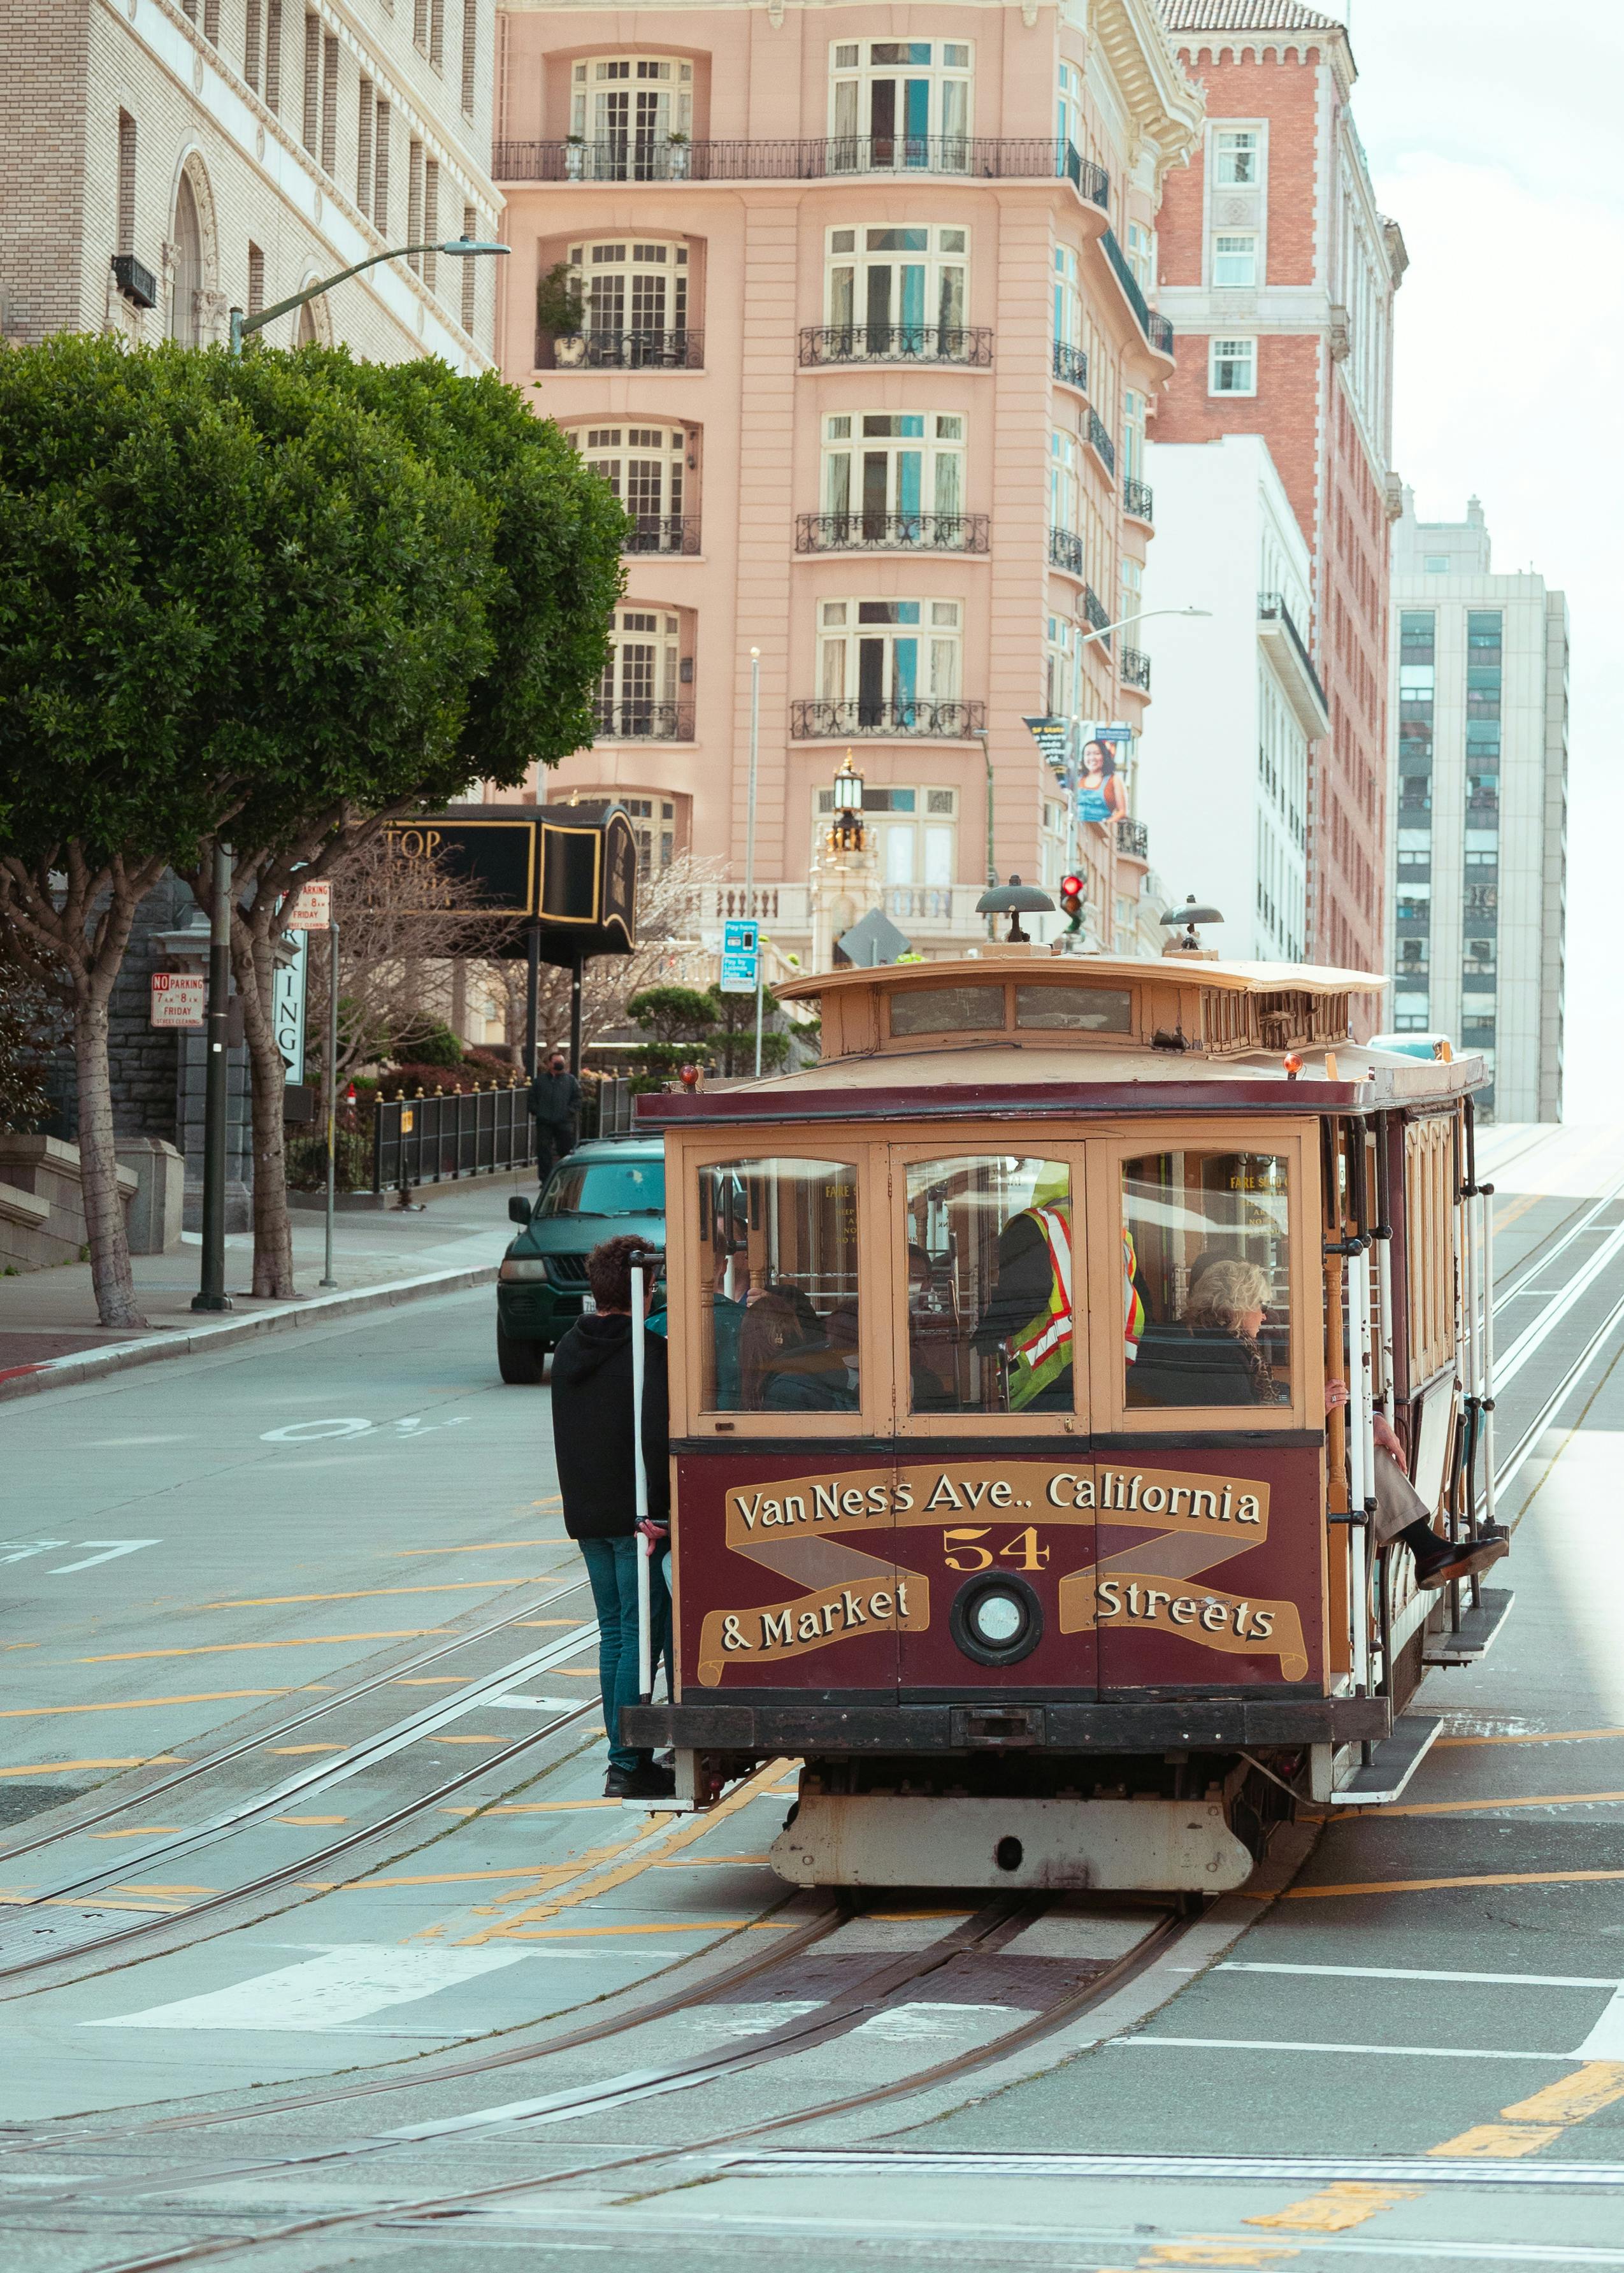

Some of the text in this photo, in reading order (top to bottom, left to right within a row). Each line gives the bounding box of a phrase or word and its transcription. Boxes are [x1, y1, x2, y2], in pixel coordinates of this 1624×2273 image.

[380, 830, 442, 859] TOP
[303, 886, 327, 894] ARKING
[311, 898, 317, 907] 8
[293, 910, 319, 919] FRIDAY
[154, 976, 203, 989] NO PARKING
[157, 993, 163, 1003] 7
[181, 993, 187, 1003] 8
[164, 1007, 192, 1015] FRIDAY
[1230, 1177, 1255, 1189] FARE
[1046, 1472, 1261, 1524] California
[943, 1526, 1050, 1571] 54
[721, 1581, 1276, 1652] & Market Streets
